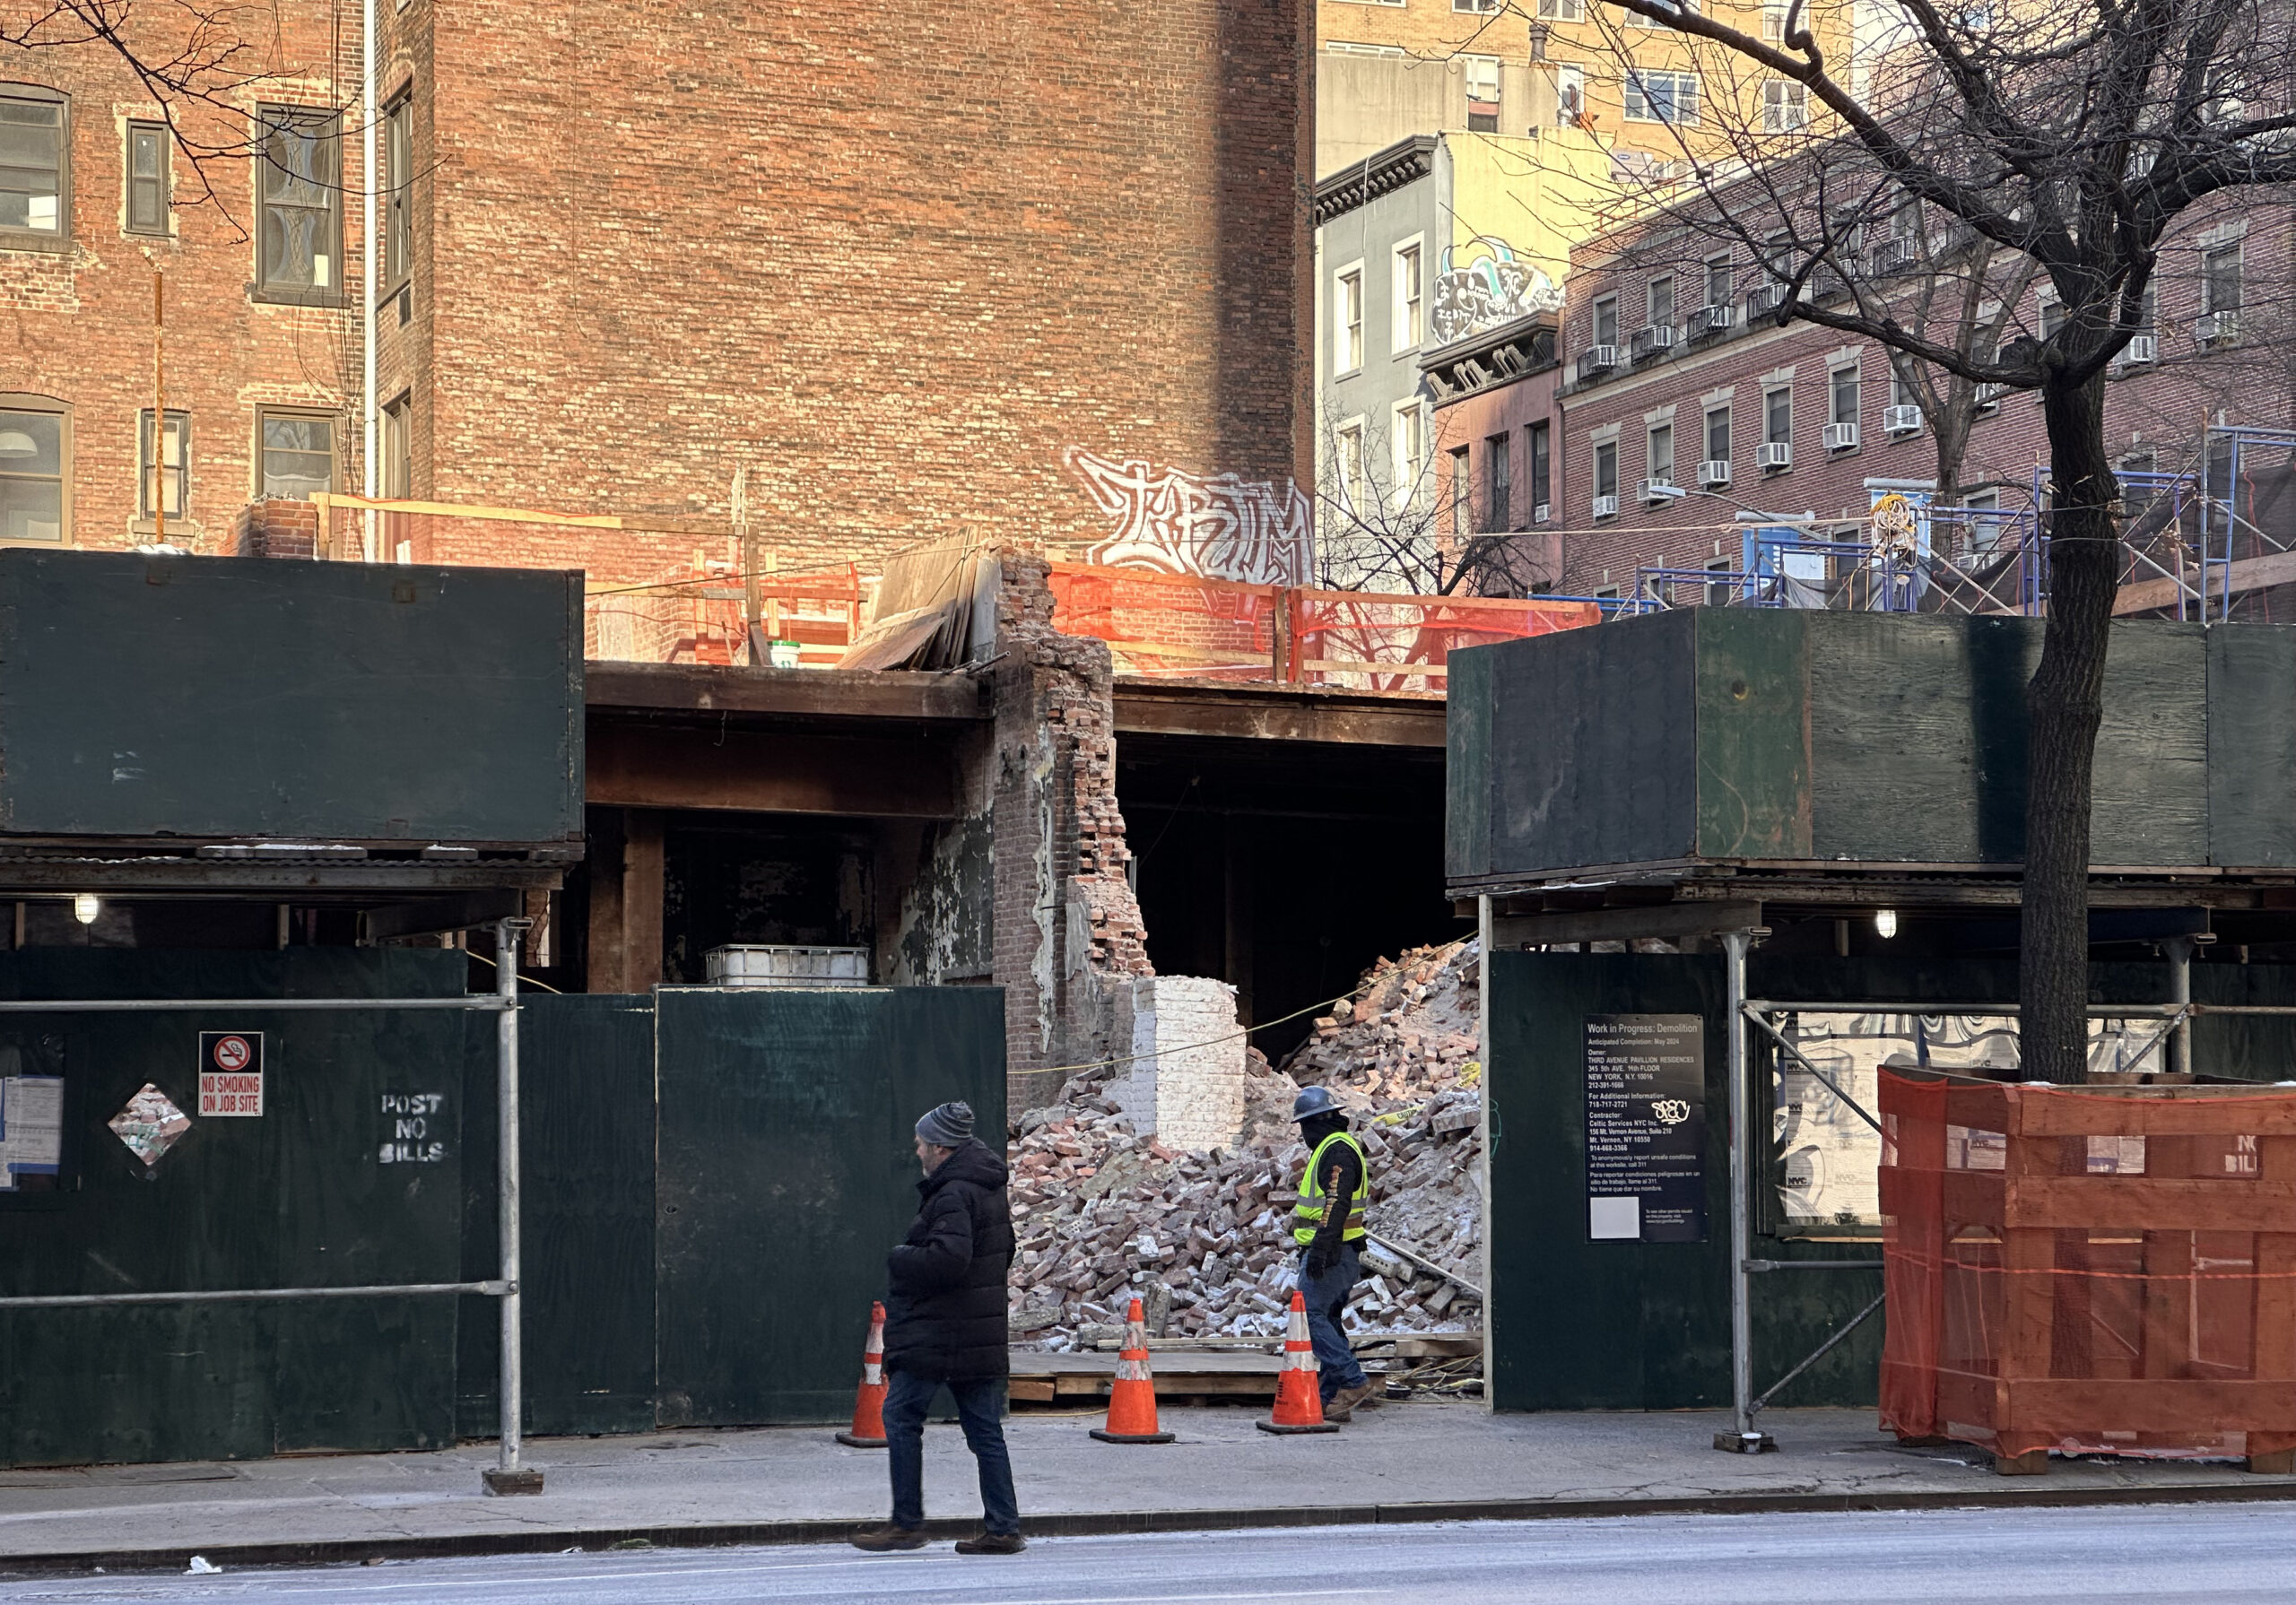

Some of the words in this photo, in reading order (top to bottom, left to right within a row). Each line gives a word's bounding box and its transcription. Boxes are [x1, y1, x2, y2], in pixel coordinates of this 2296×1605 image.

[1587, 1024, 1608, 1033] Work
[1610, 1024, 1617, 1033] in
[1619, 1024, 1655, 1035] Progress:
[1657, 1024, 1698, 1033] Demolition
[202, 1076, 214, 1093] NO
[218, 1076, 259, 1093] SMOKING
[203, 1095, 216, 1112] ON
[218, 1095, 236, 1112] JOB
[239, 1095, 258, 1112] SITE
[381, 1093, 442, 1115] POST
[396, 1116, 426, 1140] NO
[378, 1142, 444, 1164] BILLS
[1788, 1176, 1807, 1184] NYC
